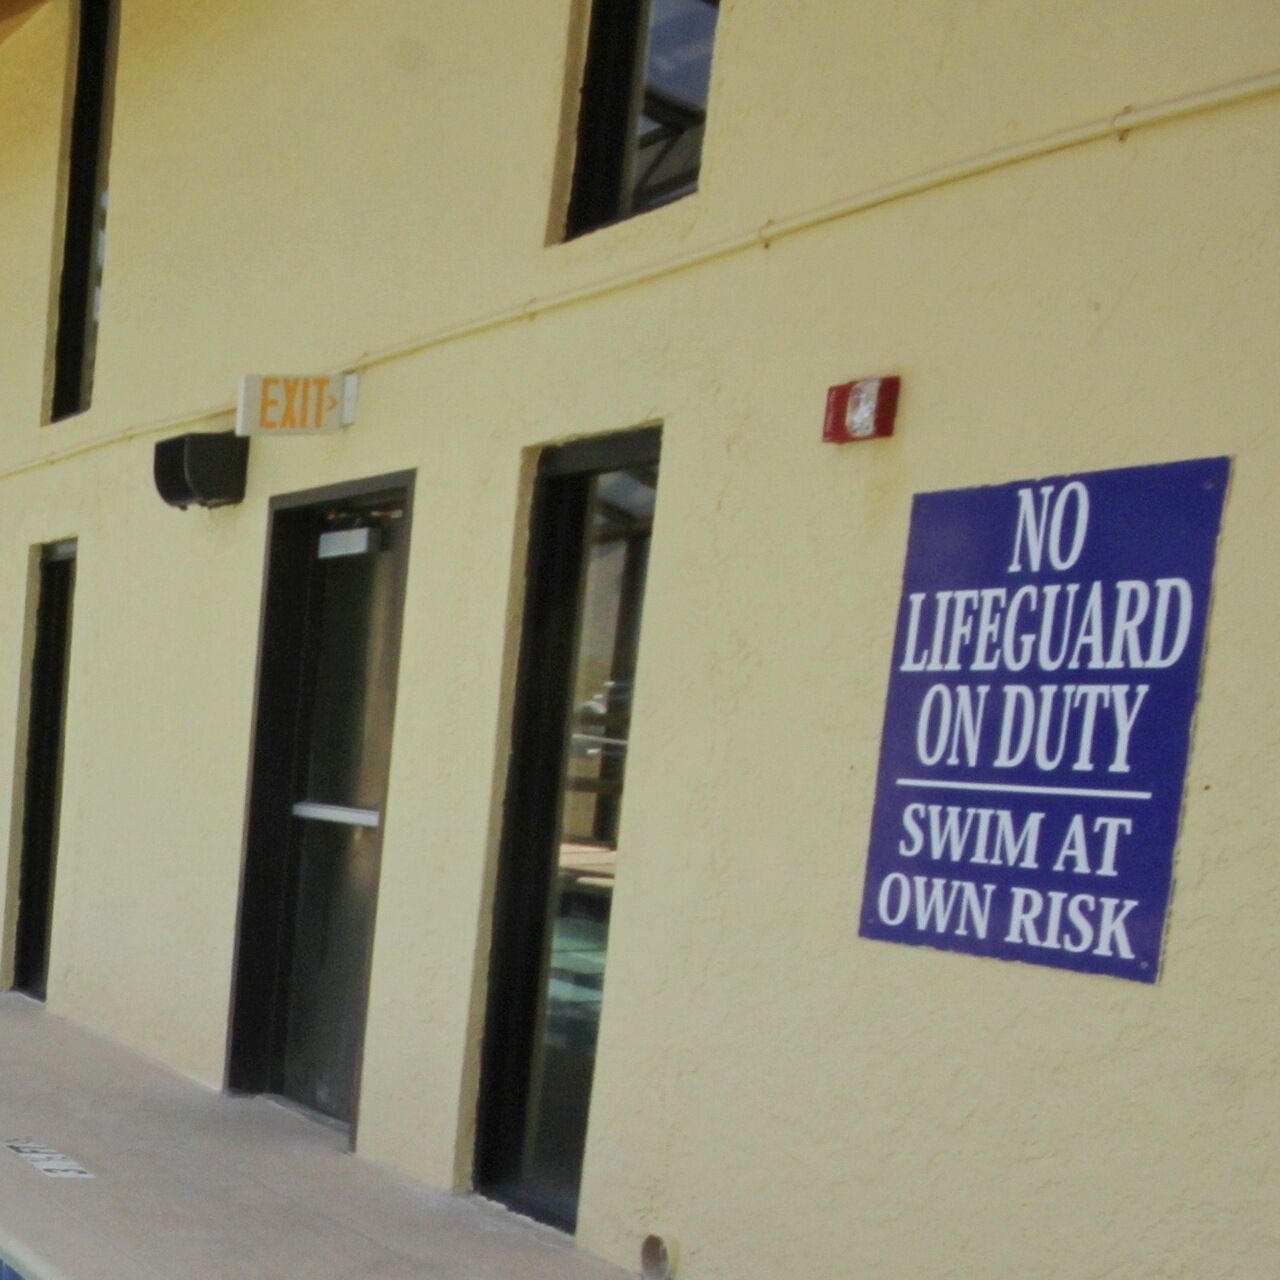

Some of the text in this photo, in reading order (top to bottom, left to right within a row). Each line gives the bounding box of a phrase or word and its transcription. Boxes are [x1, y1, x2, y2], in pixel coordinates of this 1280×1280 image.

[260, 377, 330, 429] EXIT
[1007, 480, 1090, 573] NO
[899, 577, 1193, 672] LIFEGUARD
[917, 682, 1150, 773] ON DUTY
[898, 803, 1132, 877] SWIM AT
[878, 872, 1138, 960] OWN RISK
